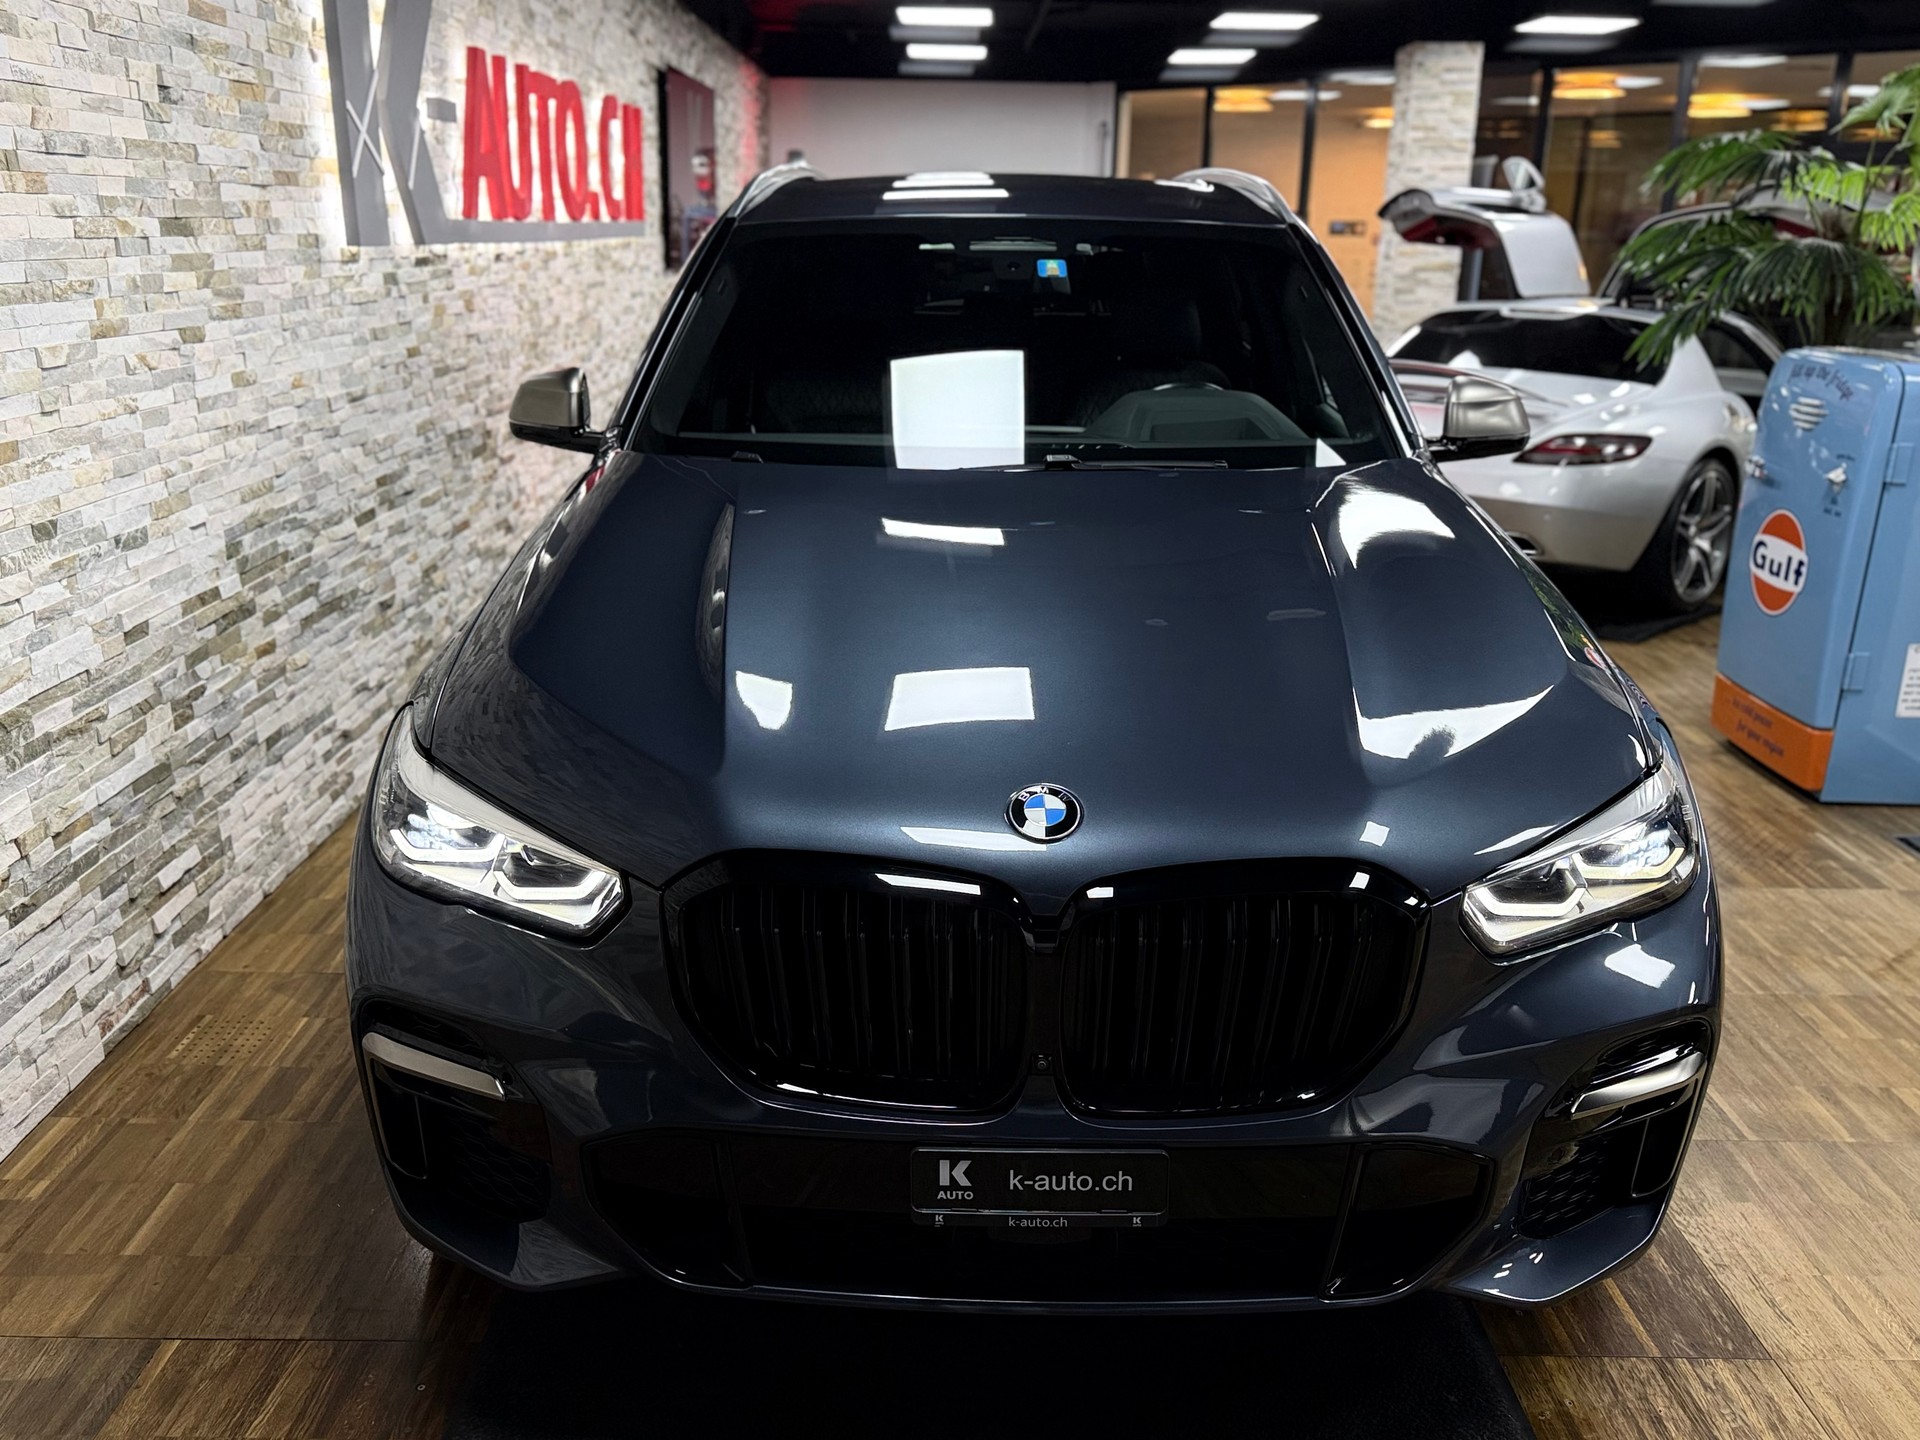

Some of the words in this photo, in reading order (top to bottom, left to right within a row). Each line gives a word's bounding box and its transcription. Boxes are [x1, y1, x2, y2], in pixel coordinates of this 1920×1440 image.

[1753, 540, 1805, 586] Gulf
[939, 1159, 972, 1186] K
[1009, 1170, 1133, 1192] k-auto.ch
[937, 1191, 974, 1200] AUTO
[1008, 1217, 1068, 1228] k-auto.ch
